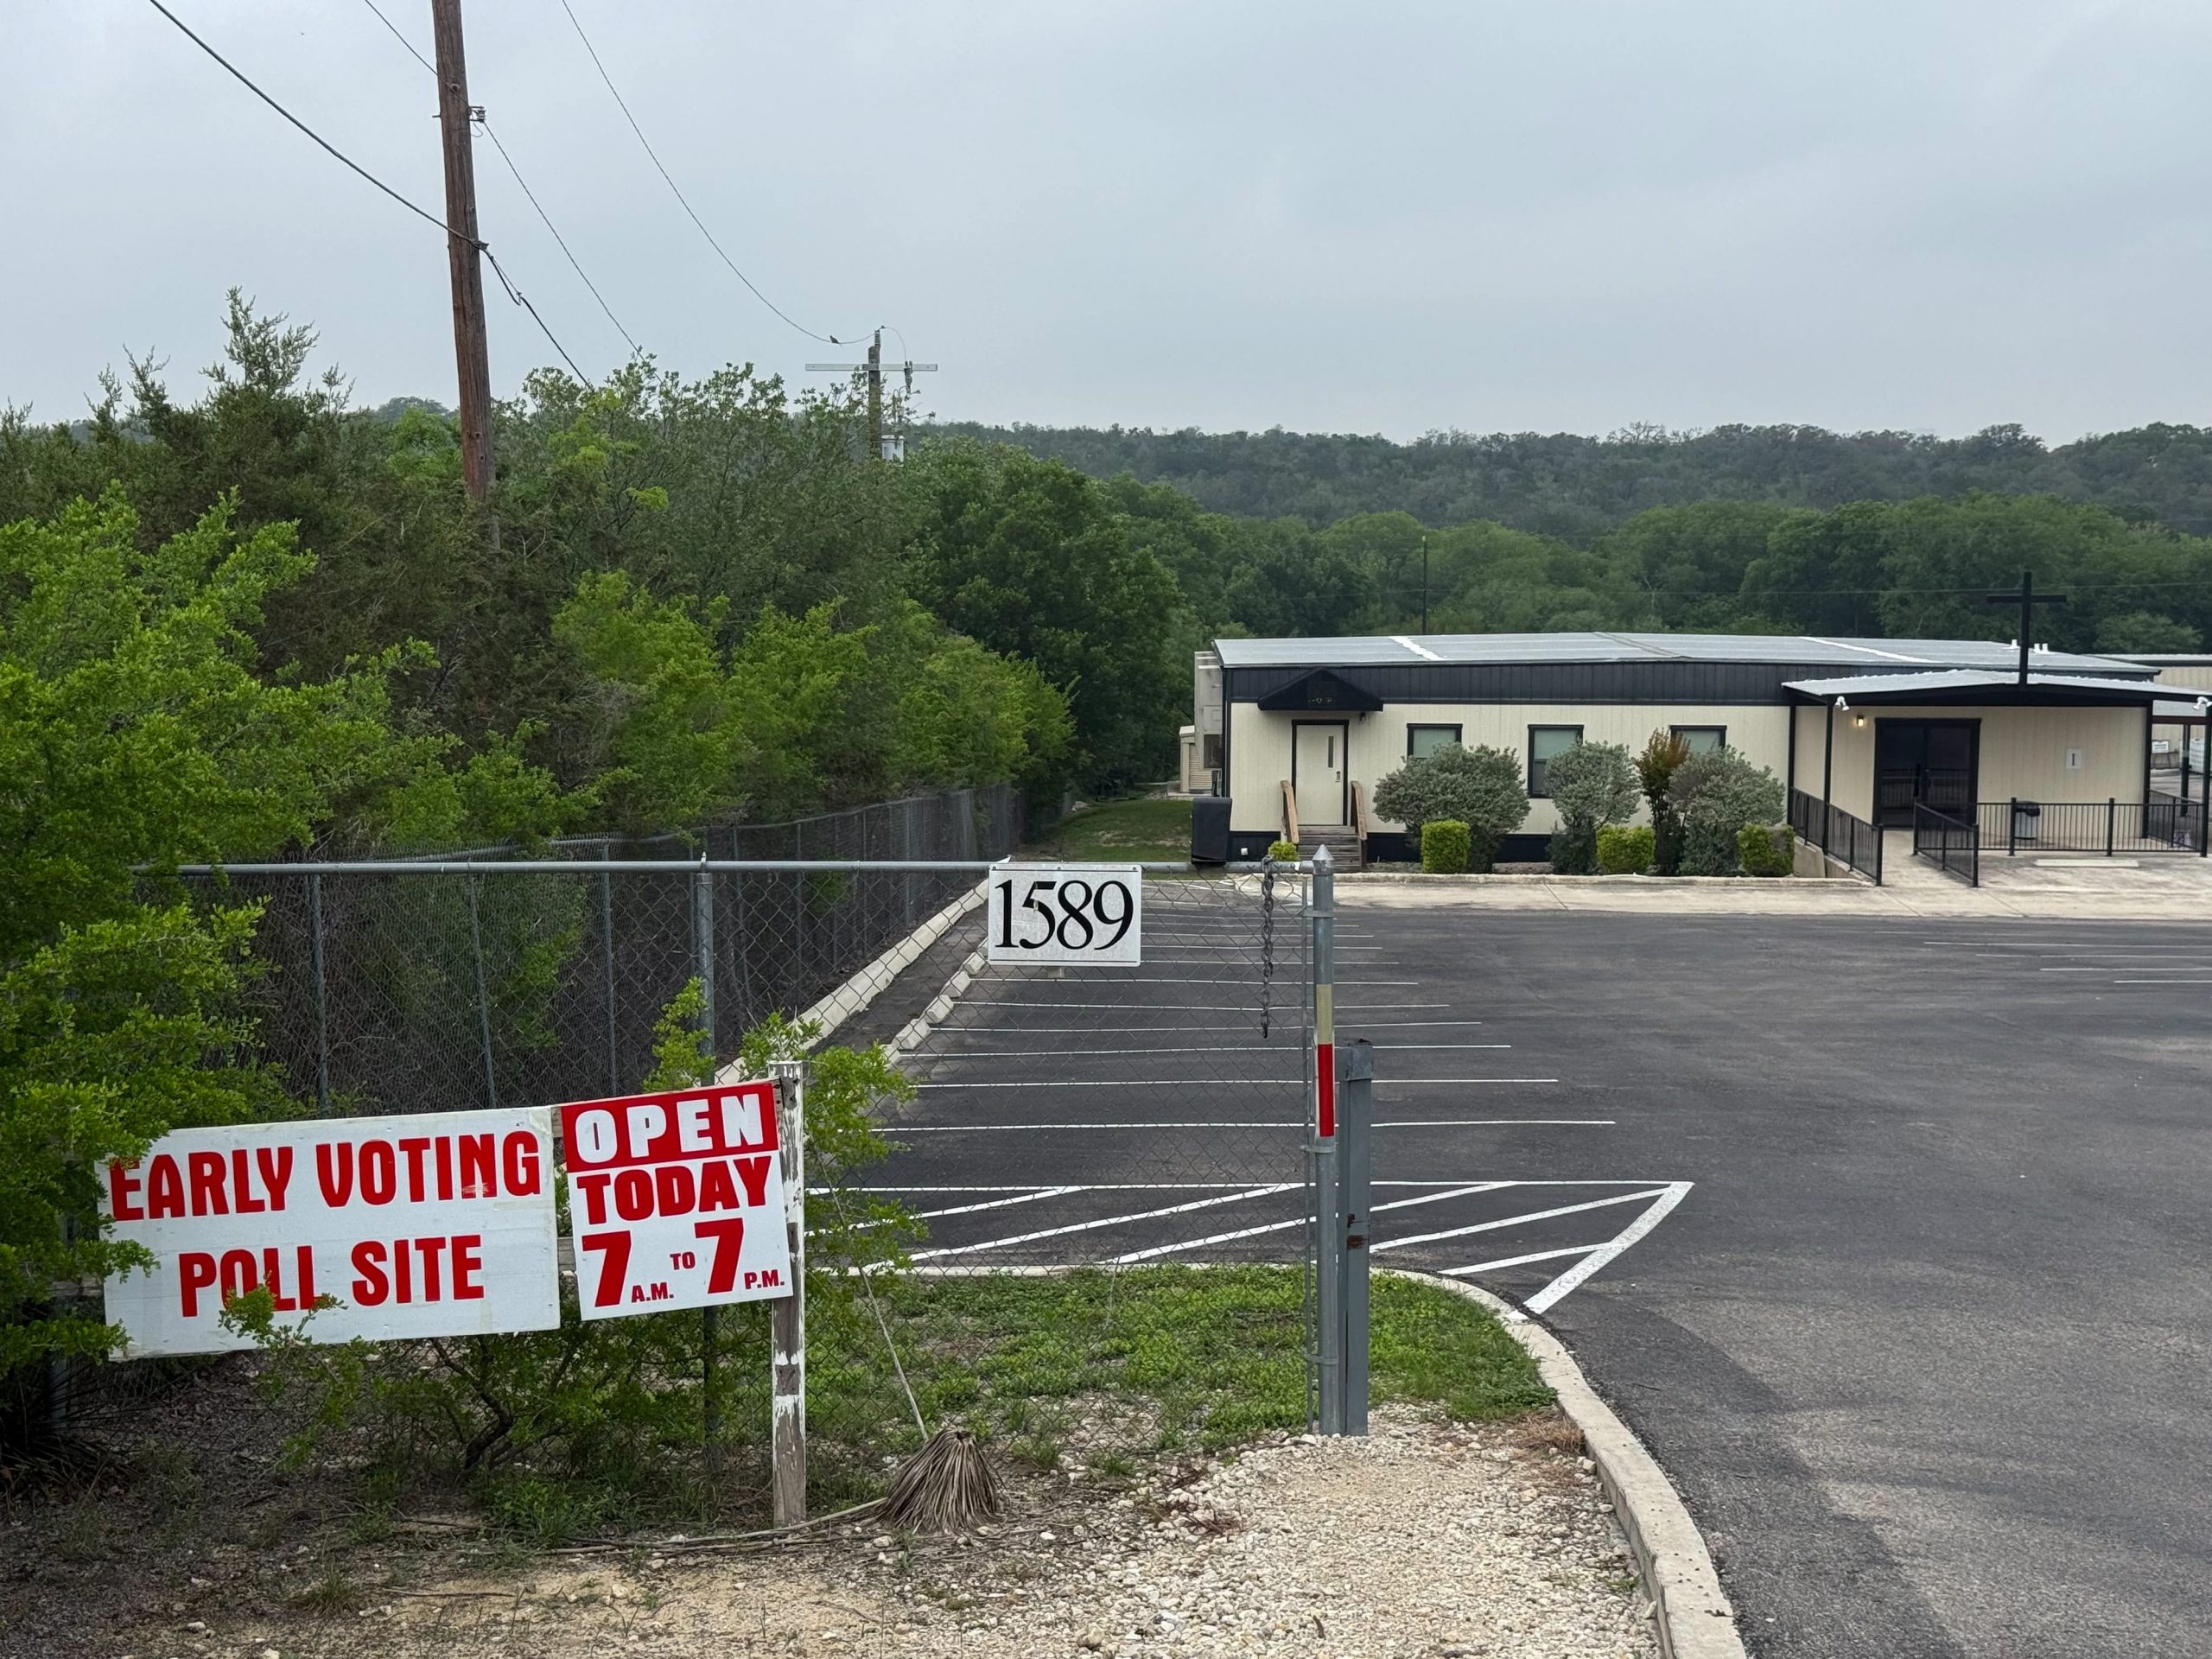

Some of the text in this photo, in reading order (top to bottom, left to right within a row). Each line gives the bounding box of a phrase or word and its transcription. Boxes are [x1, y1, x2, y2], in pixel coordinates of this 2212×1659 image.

[995, 879, 1135, 950] 1589
[575, 1093, 764, 1163] OPEN
[110, 1130, 542, 1221] EARLY VOTING
[575, 1155, 772, 1225] TODAY
[179, 1234, 485, 1318] POLL SITE
[581, 1217, 785, 1307] 7 A.M. TO 7 P.M.
